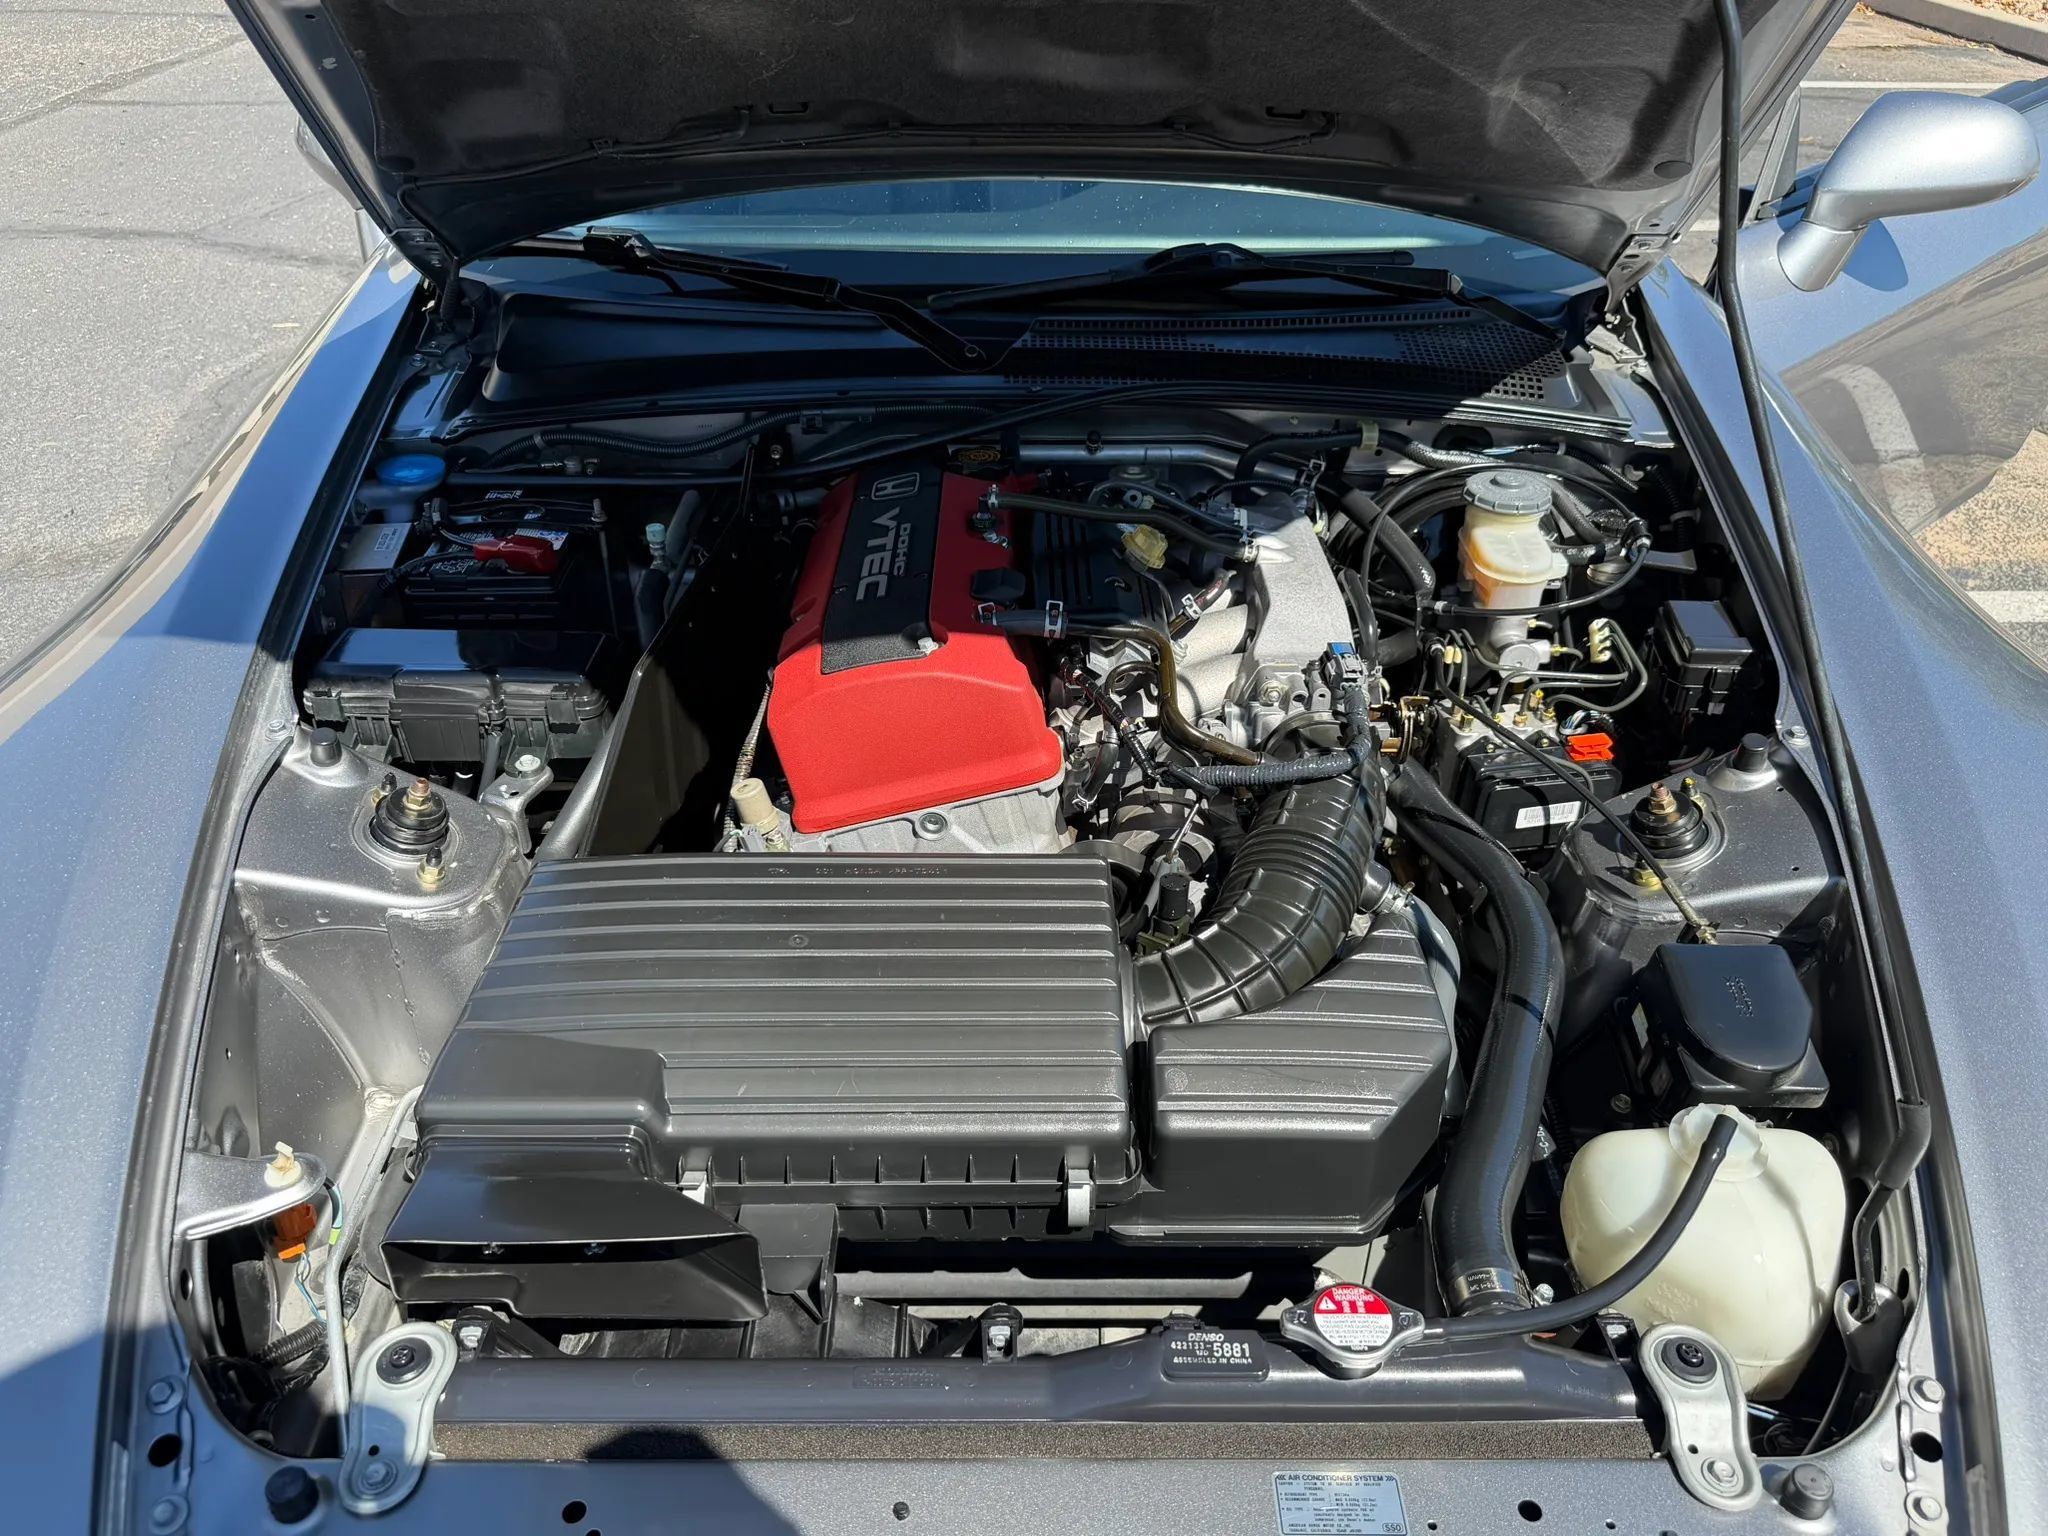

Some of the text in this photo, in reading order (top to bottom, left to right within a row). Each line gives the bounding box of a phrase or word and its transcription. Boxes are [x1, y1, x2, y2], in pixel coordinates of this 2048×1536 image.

[856, 506, 900, 602] VTEC
[893, 523, 911, 576] DOHC
[1332, 1287, 1365, 1295] DANGER
[1188, 1332, 1224, 1342] DENSO
[1229, 1357, 1252, 1365] CHINA
